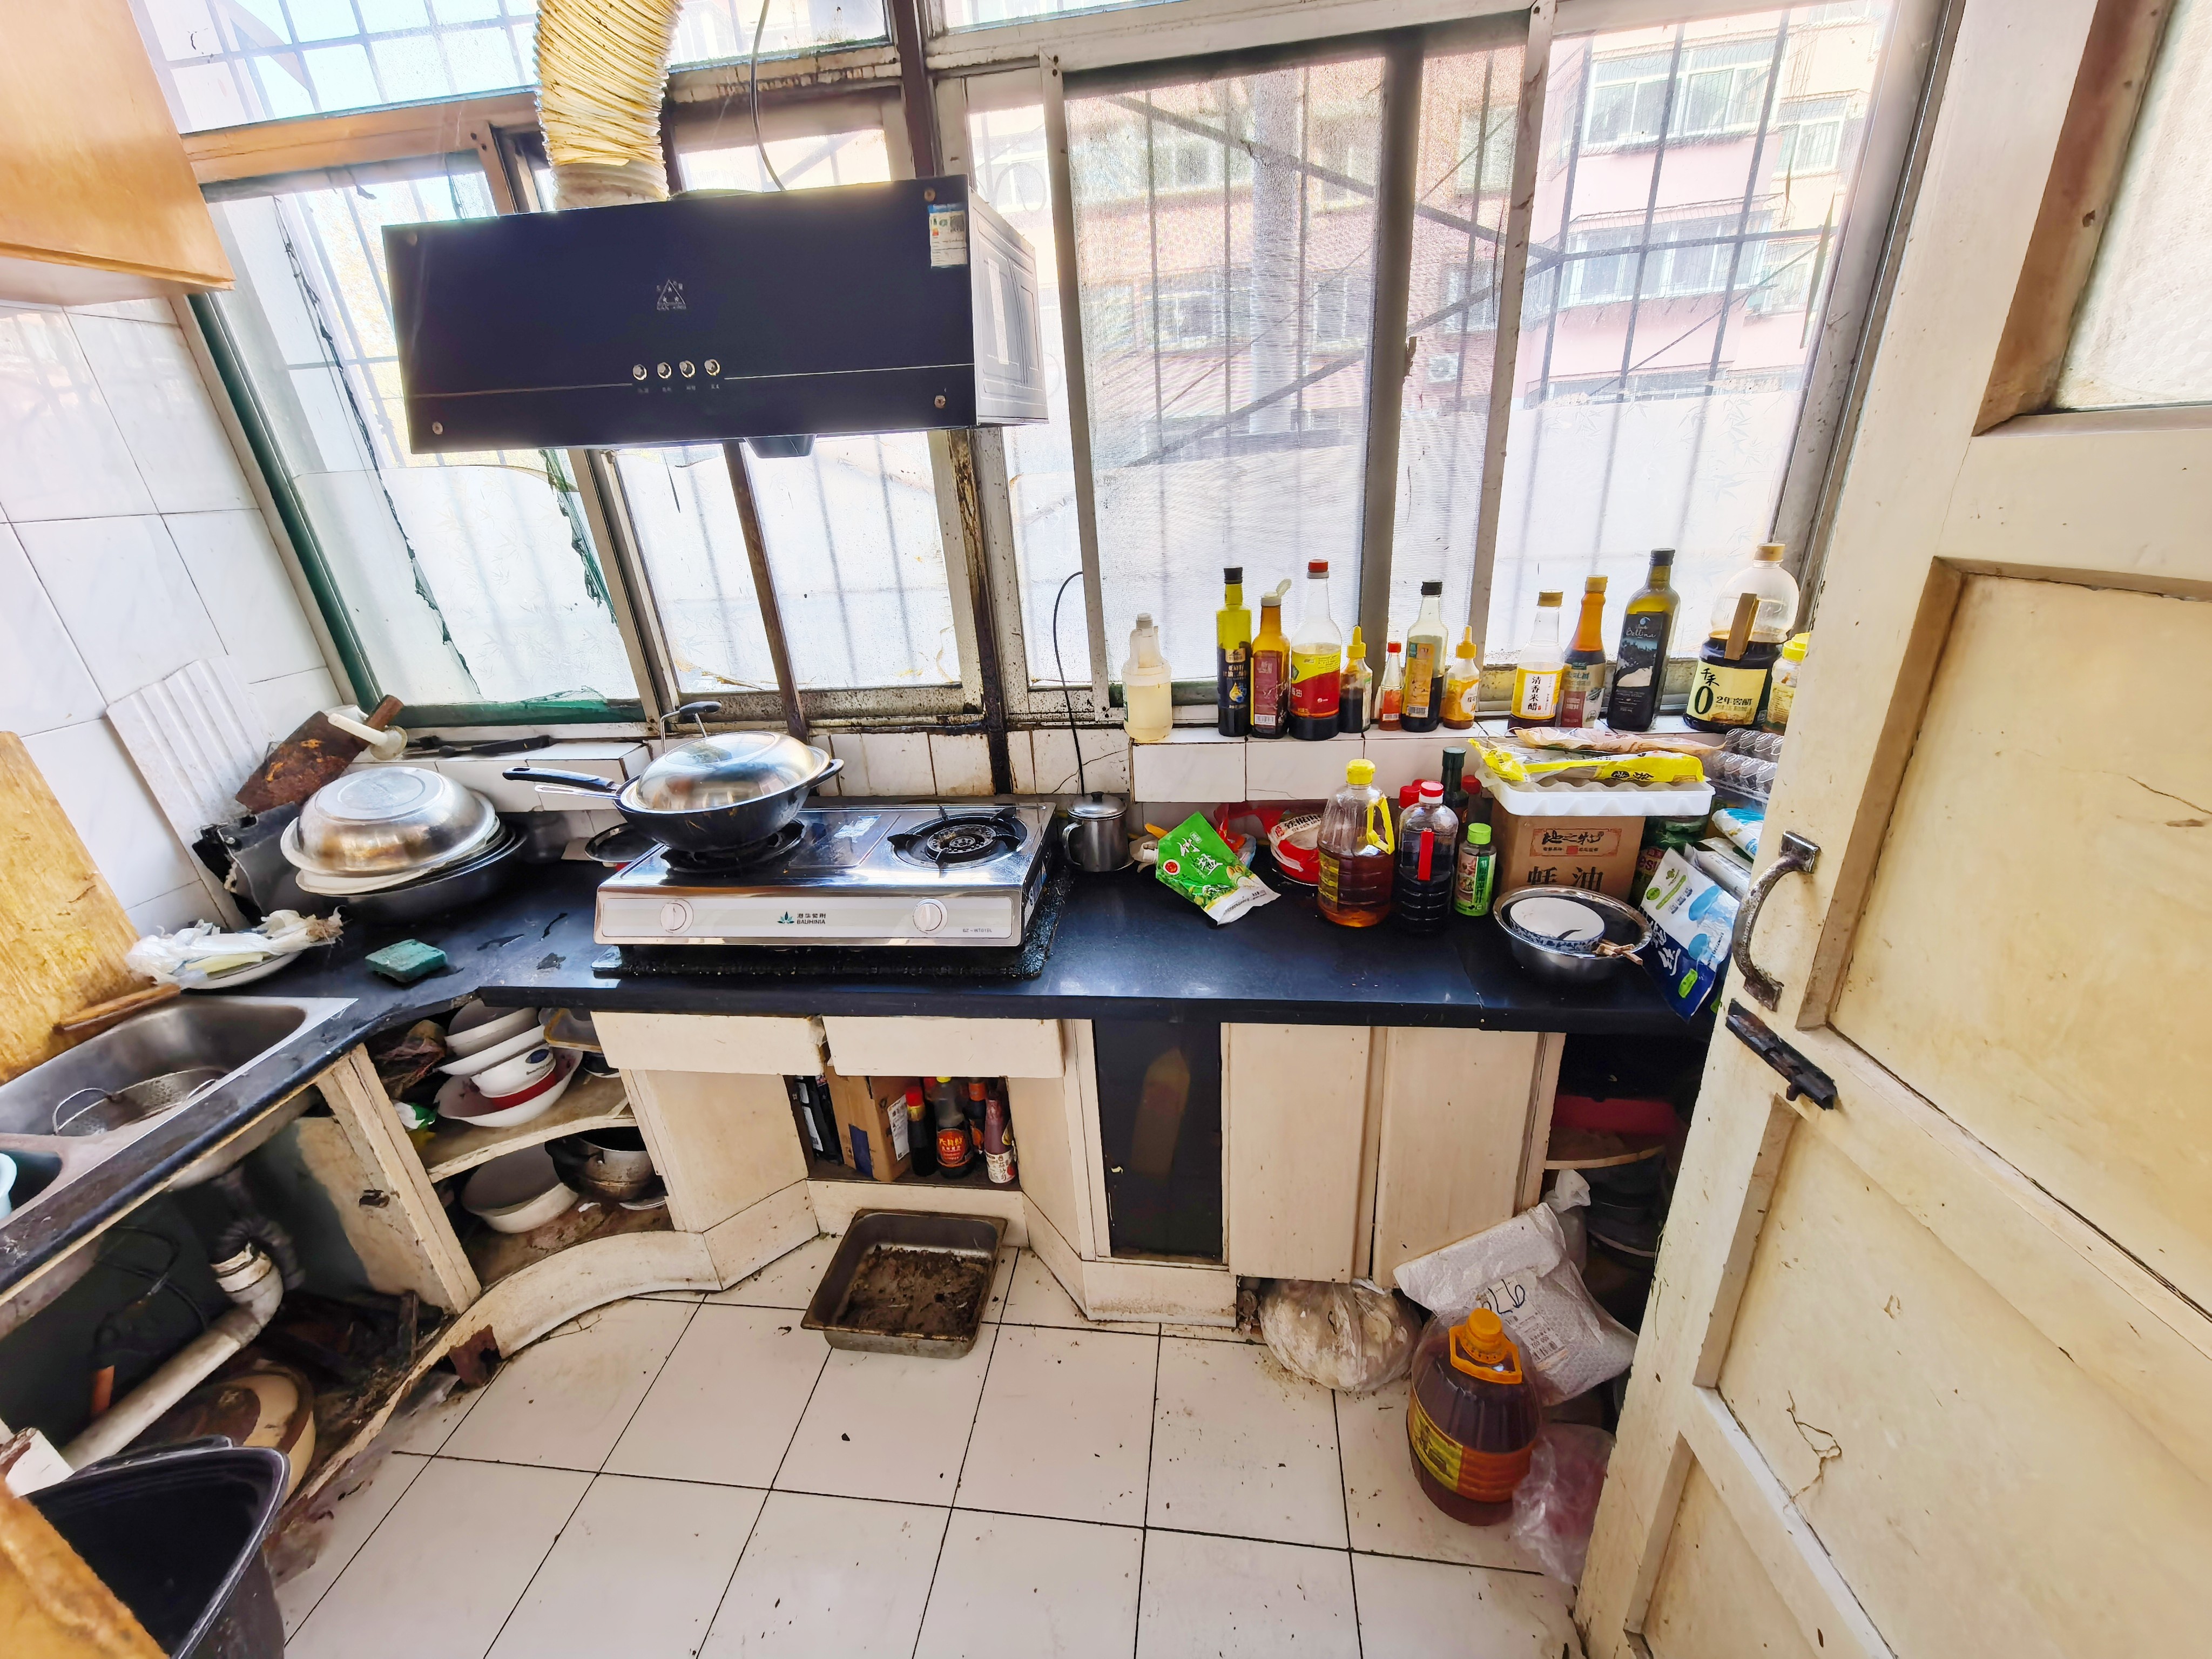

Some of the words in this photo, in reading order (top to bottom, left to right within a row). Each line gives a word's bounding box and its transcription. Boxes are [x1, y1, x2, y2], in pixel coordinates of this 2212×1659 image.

[1701, 667, 1719, 686] 千禾
[1528, 676, 1541, 711] 清香米醋
